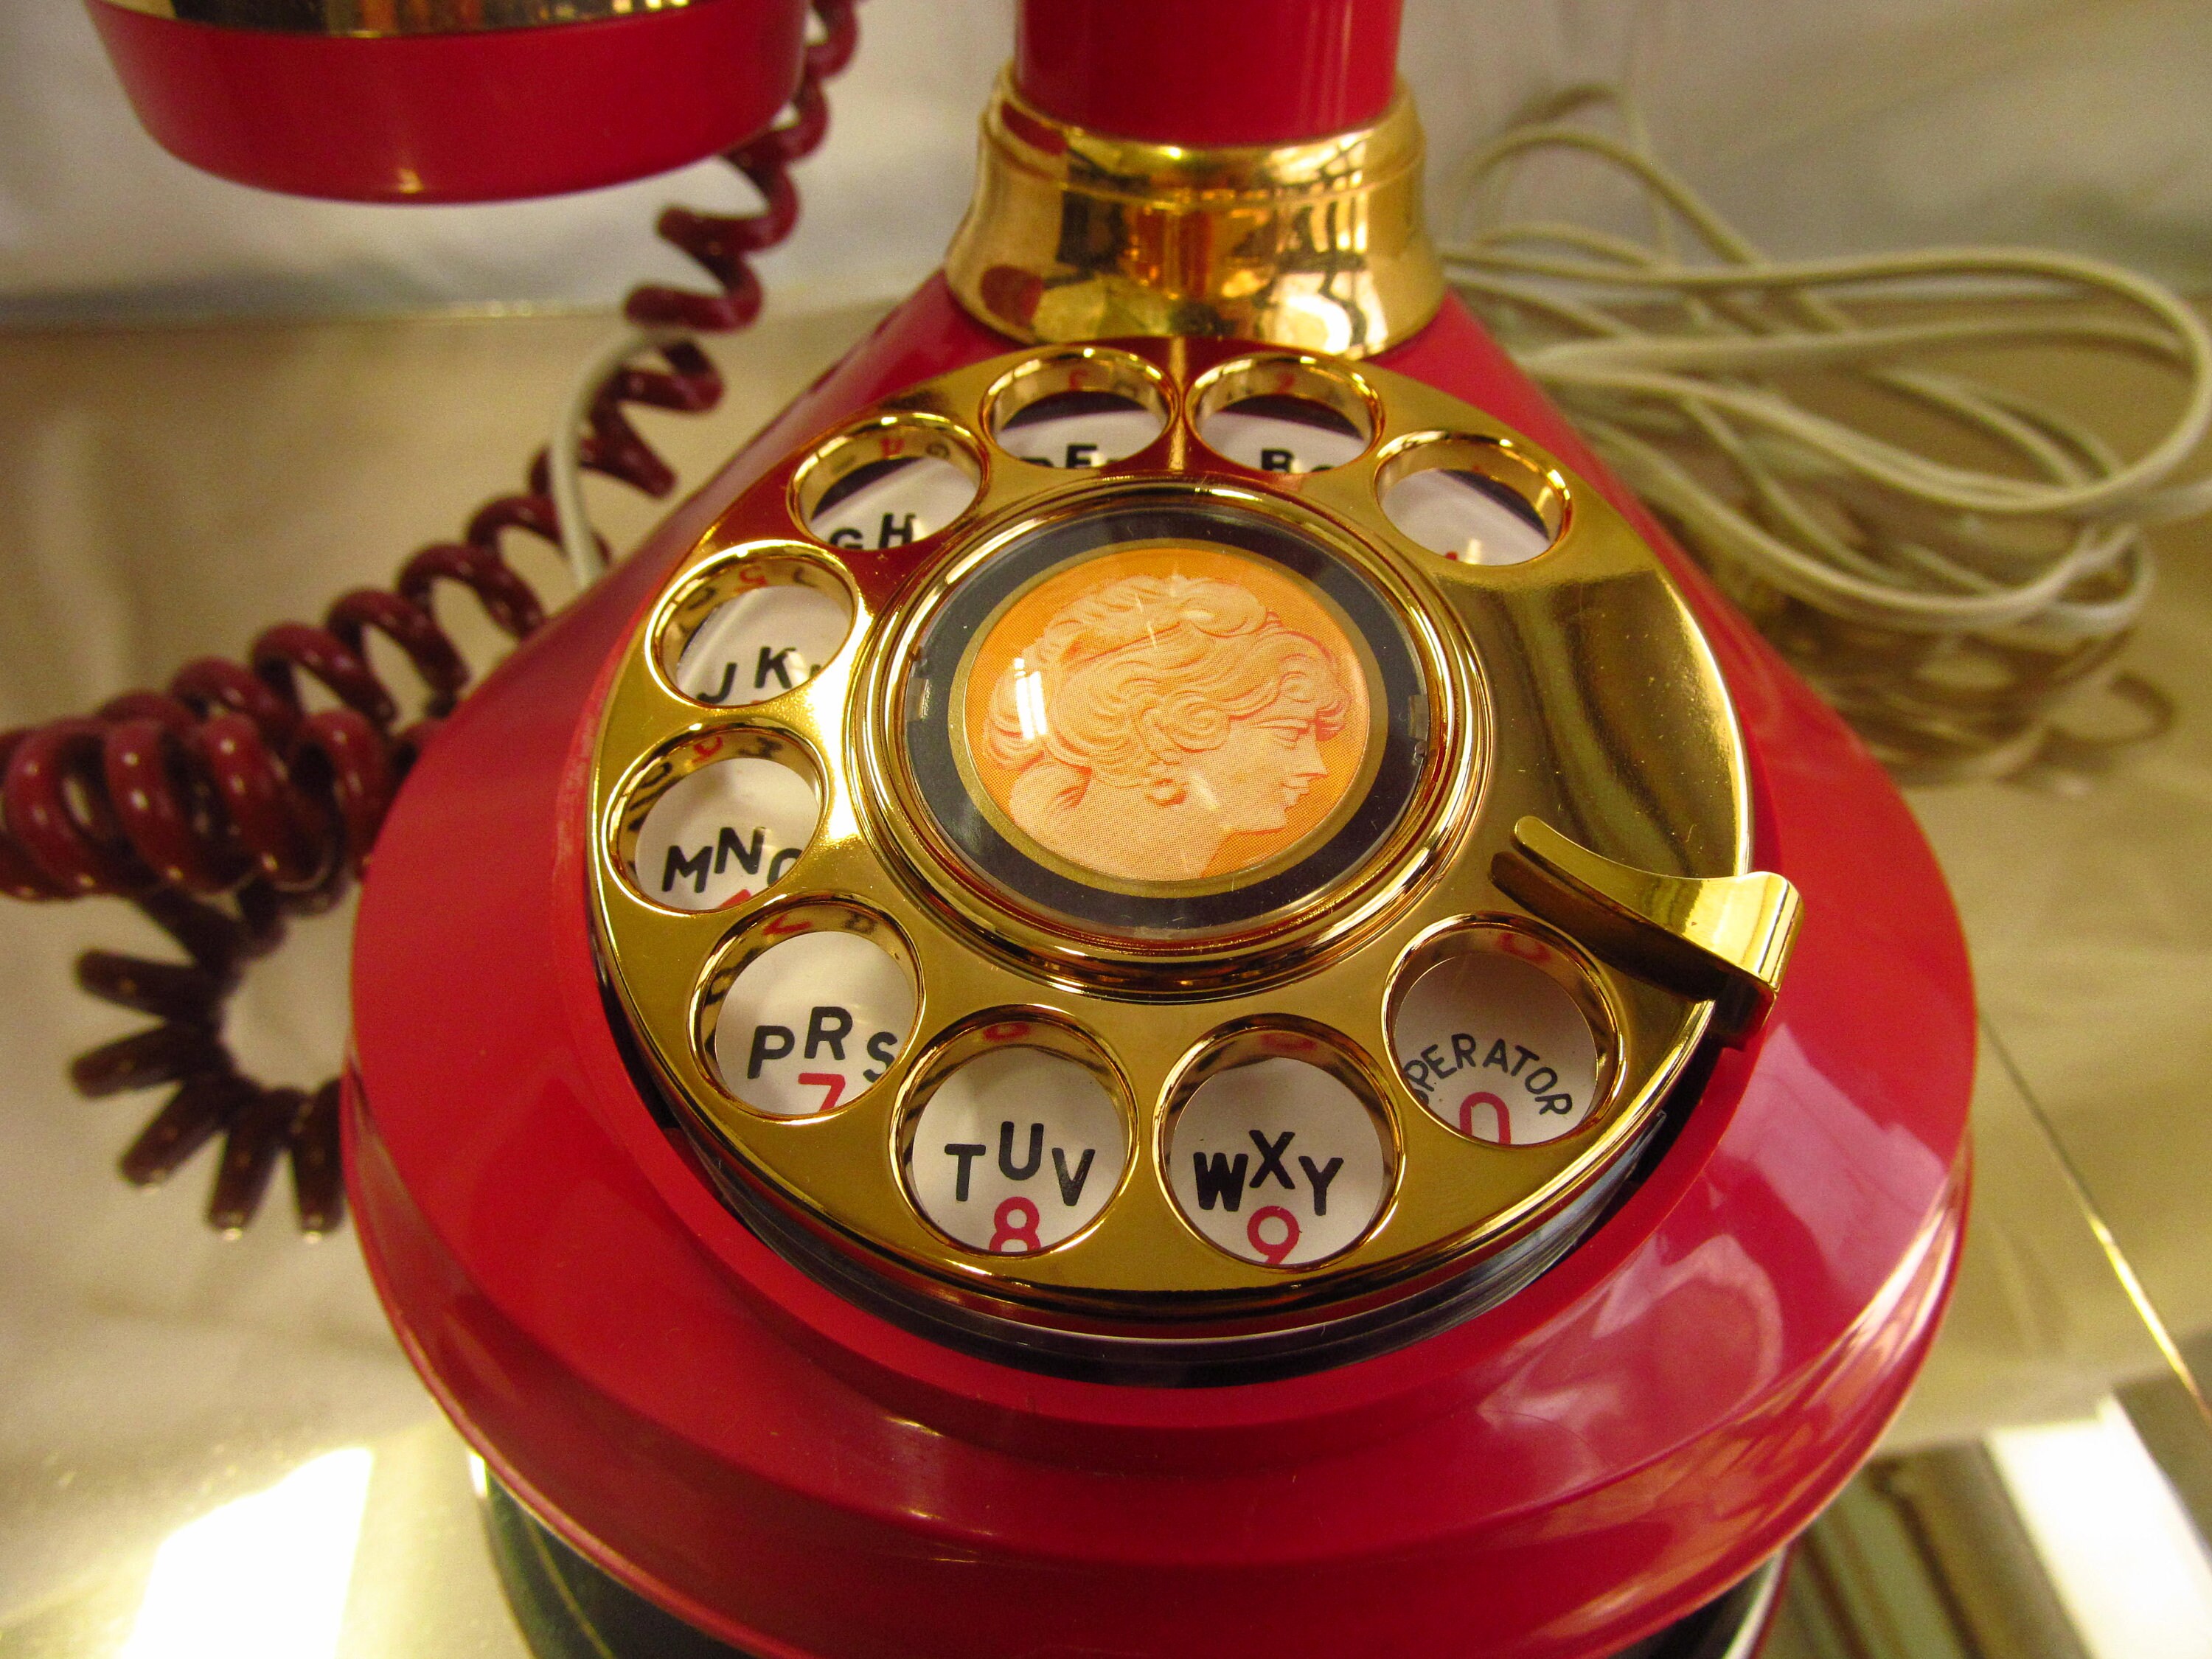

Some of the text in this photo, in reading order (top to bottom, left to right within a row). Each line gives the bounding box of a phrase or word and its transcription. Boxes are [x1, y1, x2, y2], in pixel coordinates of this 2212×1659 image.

[1262, 448, 1332, 473] B
[696, 646, 821, 703] JK
[747, 1006, 898, 1083] PRS
[798, 1072, 846, 1112] 7
[944, 1120, 1096, 1206] TUV
[1193, 1130, 1344, 1216] WXY
[989, 1196, 1041, 1252] 8
[1247, 1205, 1300, 1265] 9
